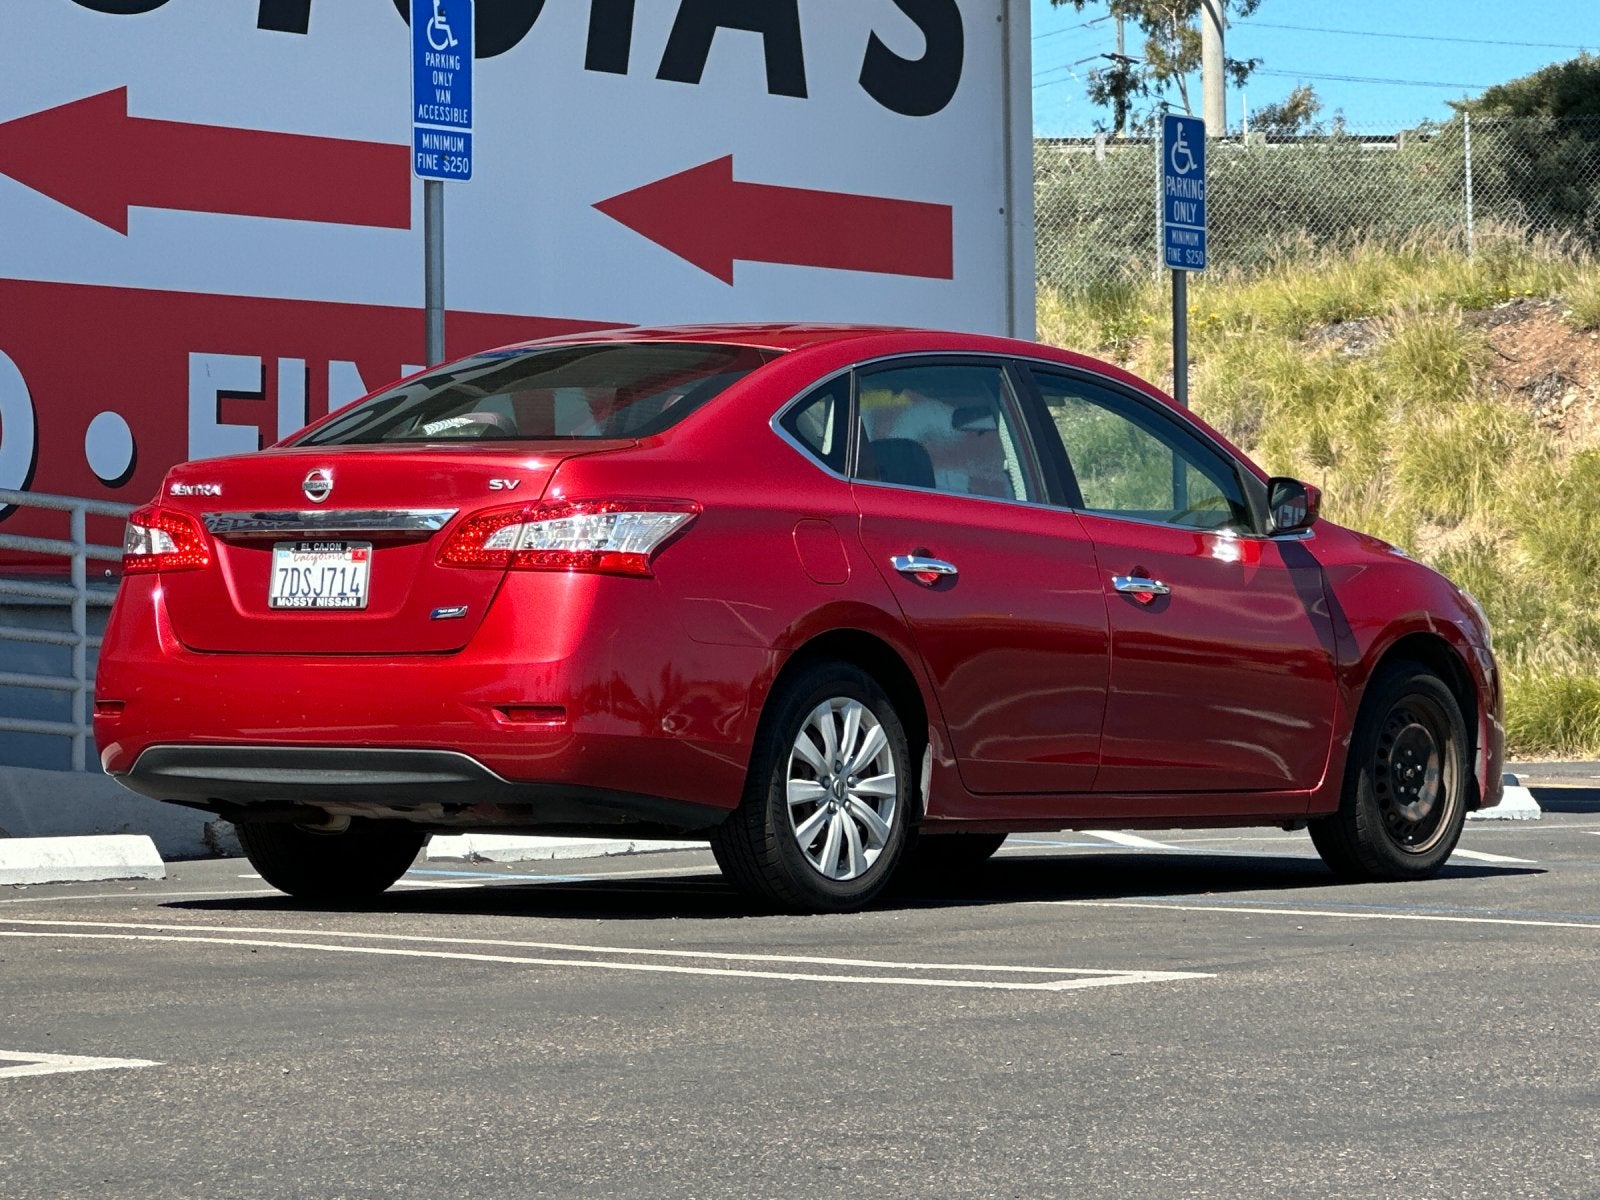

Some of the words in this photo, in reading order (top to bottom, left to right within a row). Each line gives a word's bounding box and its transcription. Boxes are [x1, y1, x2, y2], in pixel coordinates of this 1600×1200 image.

[425, 52, 461, 70] PARKING
[432, 70, 453, 87] ONLY
[435, 88, 451, 105] VAN
[418, 104, 468, 123] ACCESSIBLE
[422, 133, 464, 153] MINIMUM
[417, 152, 439, 170] FINE
[443, 155, 469, 174] $250
[1165, 175, 1204, 201] PARKING
[1173, 200, 1197, 223] ONLY
[1171, 229, 1199, 247] MINIMUM
[1167, 247, 1182, 263] FINE
[1185, 249, 1204, 265] $250
[170, 482, 222, 496] SENTRA
[303, 481, 330, 490] NISSAN
[488, 478, 521, 490] SV
[301, 542, 312, 551] EL
[313, 542, 342, 551] CAJON
[278, 566, 361, 597] 7DSJ714
[276, 597, 315, 607] MOSSY
[316, 597, 357, 607] NISSAN
